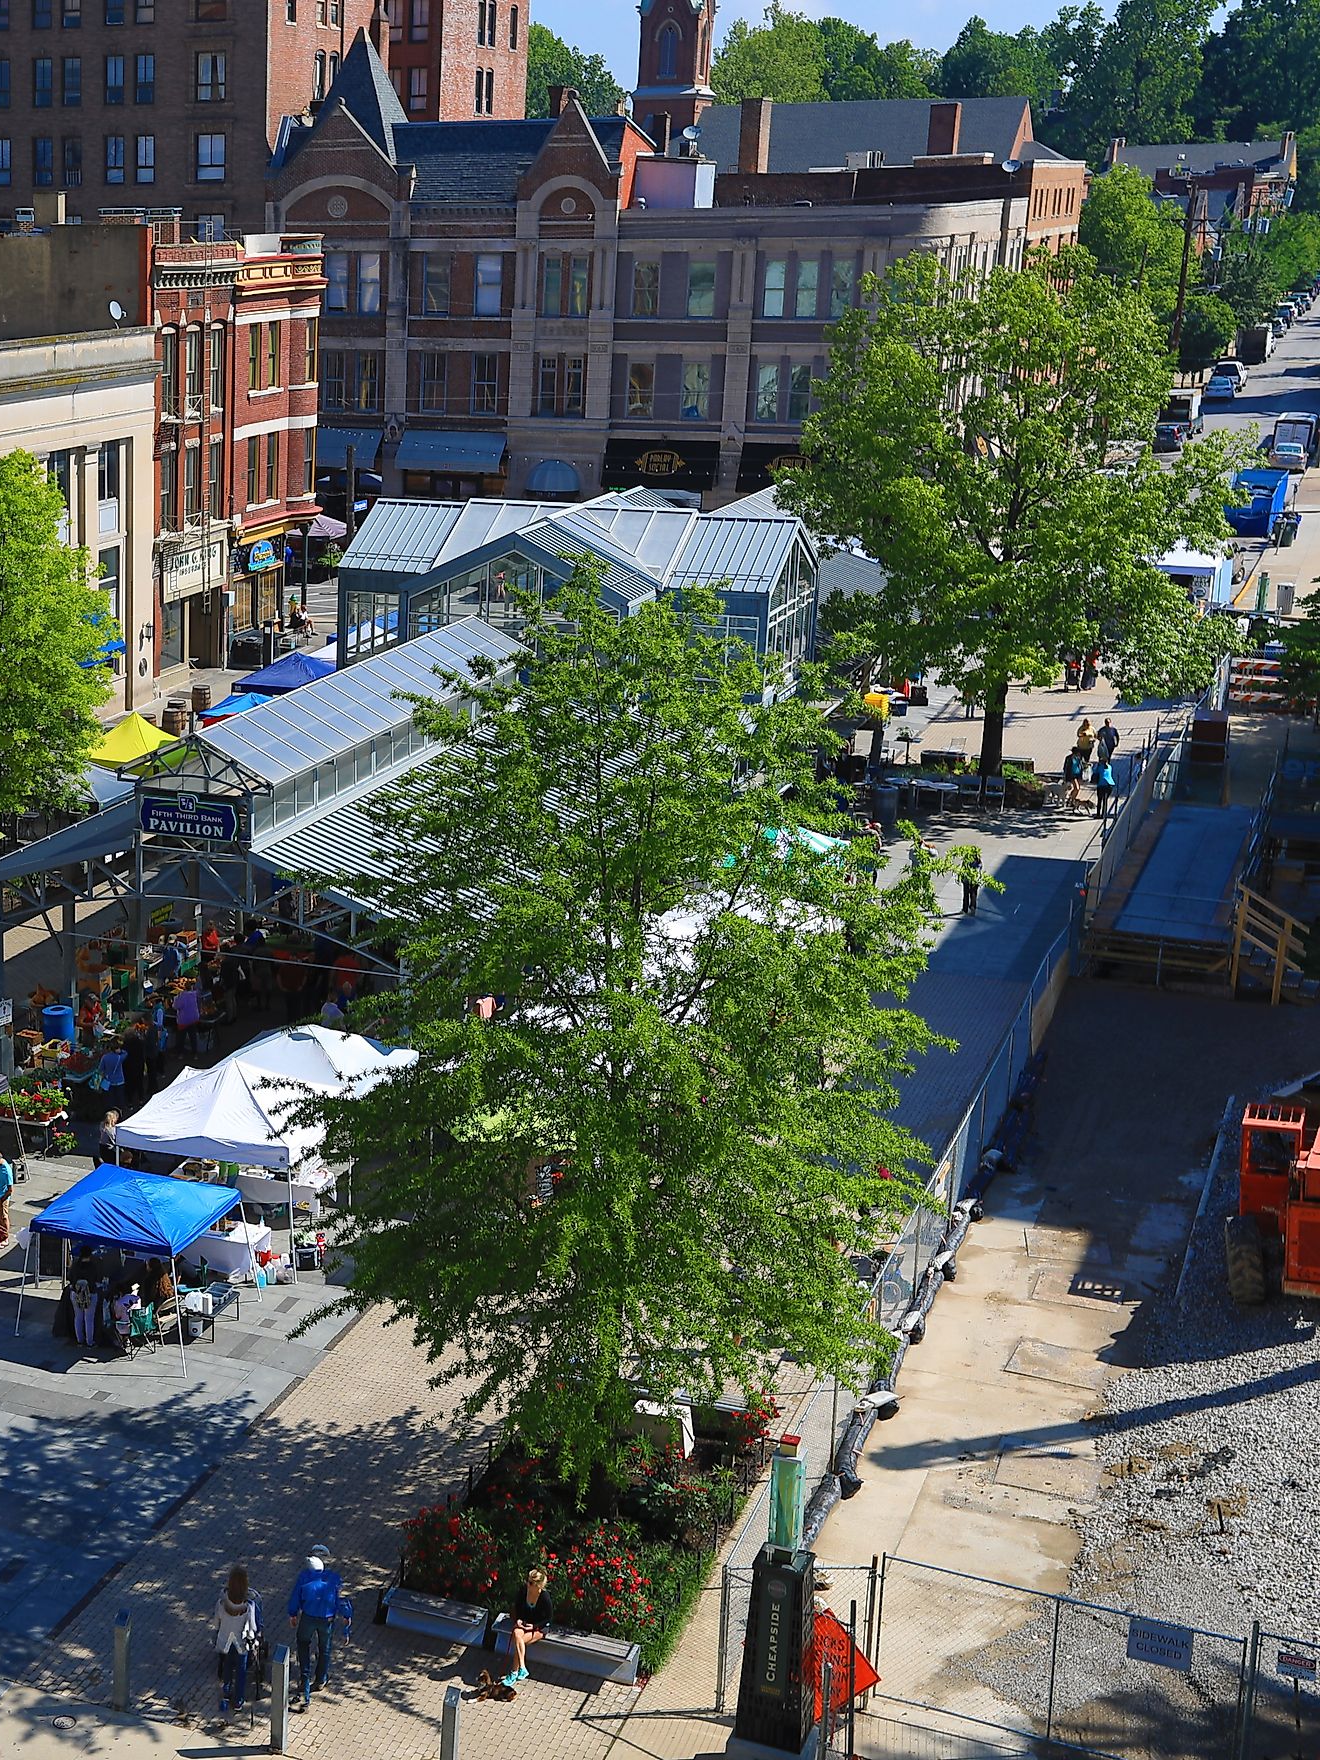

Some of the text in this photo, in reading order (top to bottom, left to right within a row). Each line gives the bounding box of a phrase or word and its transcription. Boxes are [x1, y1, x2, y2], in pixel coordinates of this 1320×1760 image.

[170, 553, 189, 571] JOHN
[151, 809, 223, 824] FIFTH THIRD BANK
[149, 817, 224, 837] PAVILION
[766, 1602, 781, 1682] CHEAPSIDE
[1132, 1628, 1190, 1650] SIDEWALK
[1136, 1641, 1182, 1660] CLOSED
[1282, 1656, 1311, 1668] DANGER
